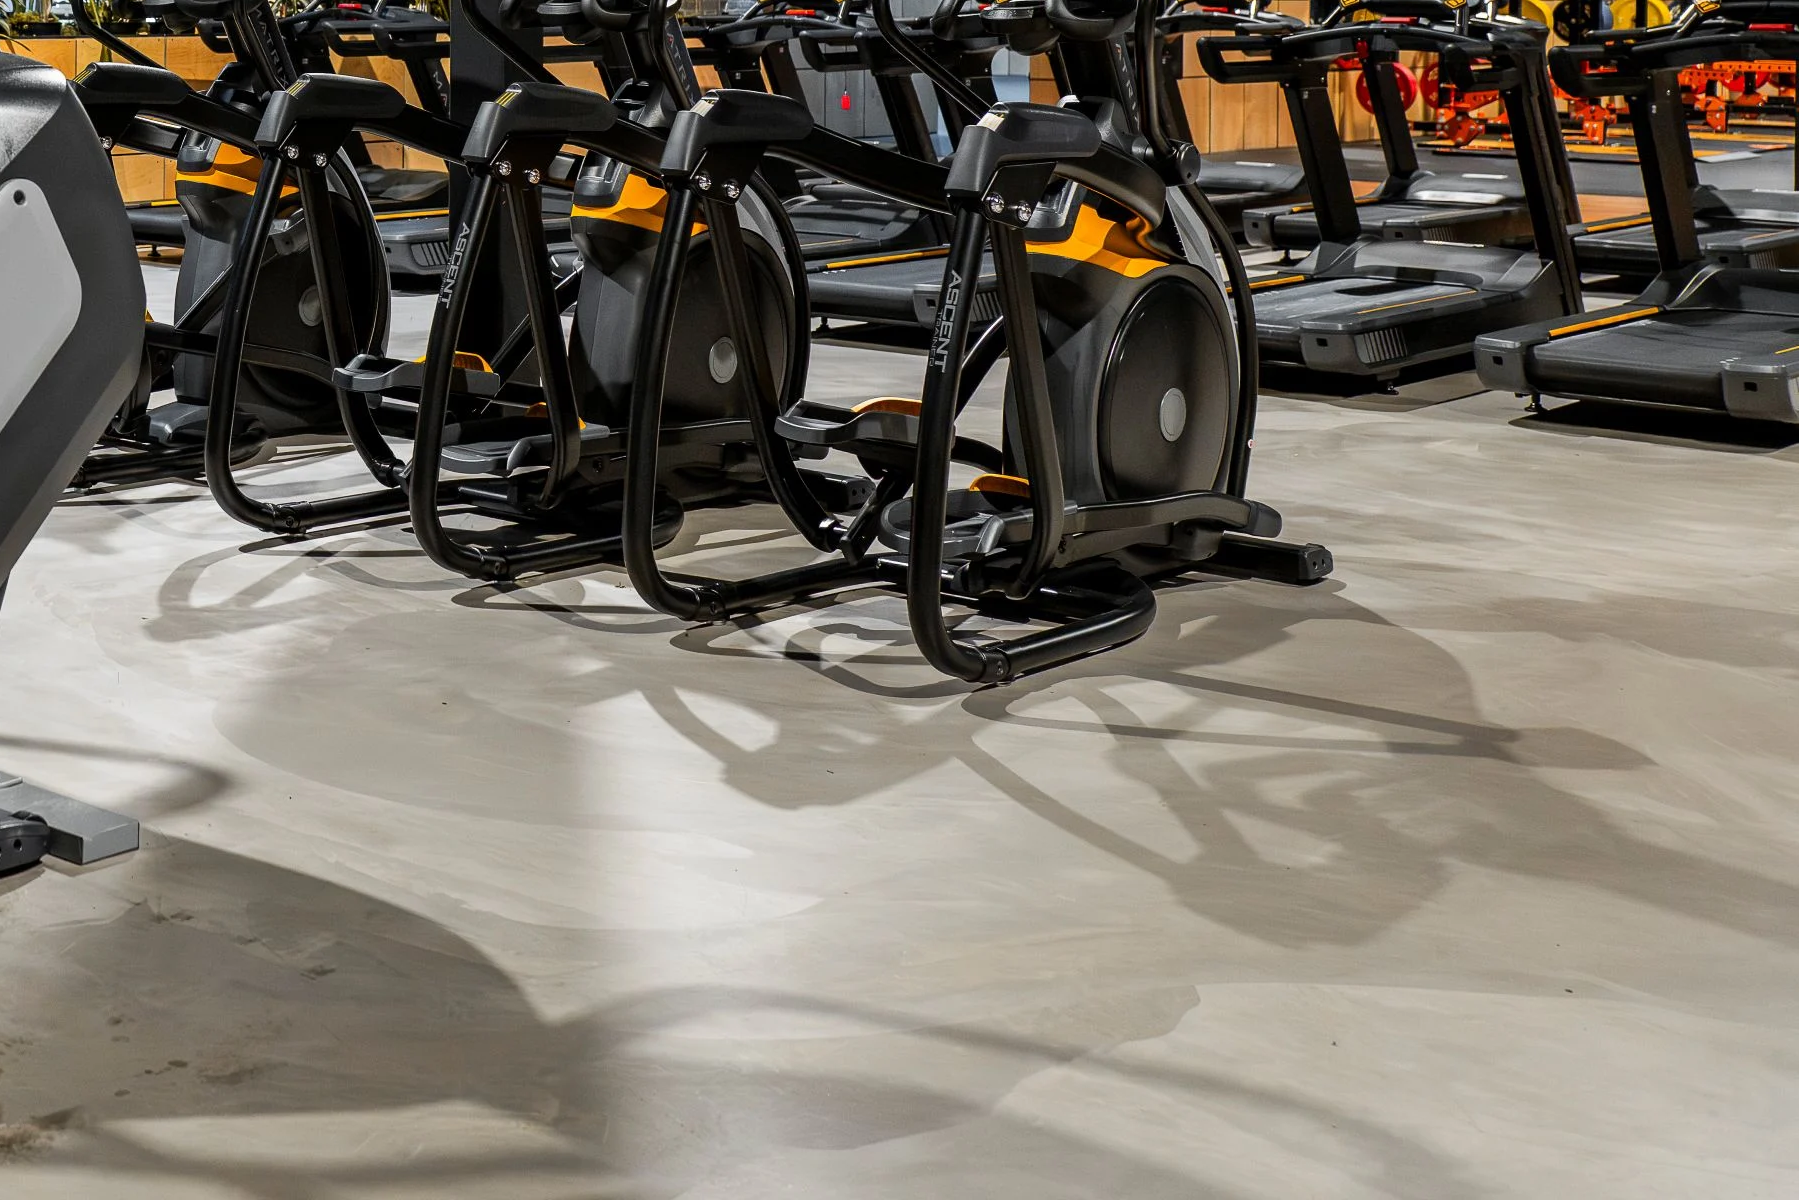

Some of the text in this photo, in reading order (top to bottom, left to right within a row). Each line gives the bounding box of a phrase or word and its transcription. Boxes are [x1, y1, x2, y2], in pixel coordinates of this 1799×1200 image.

[1115, 43, 1141, 131] ATRIX
[442, 222, 470, 309] ASCENT
[935, 269, 962, 373] ASCENT
